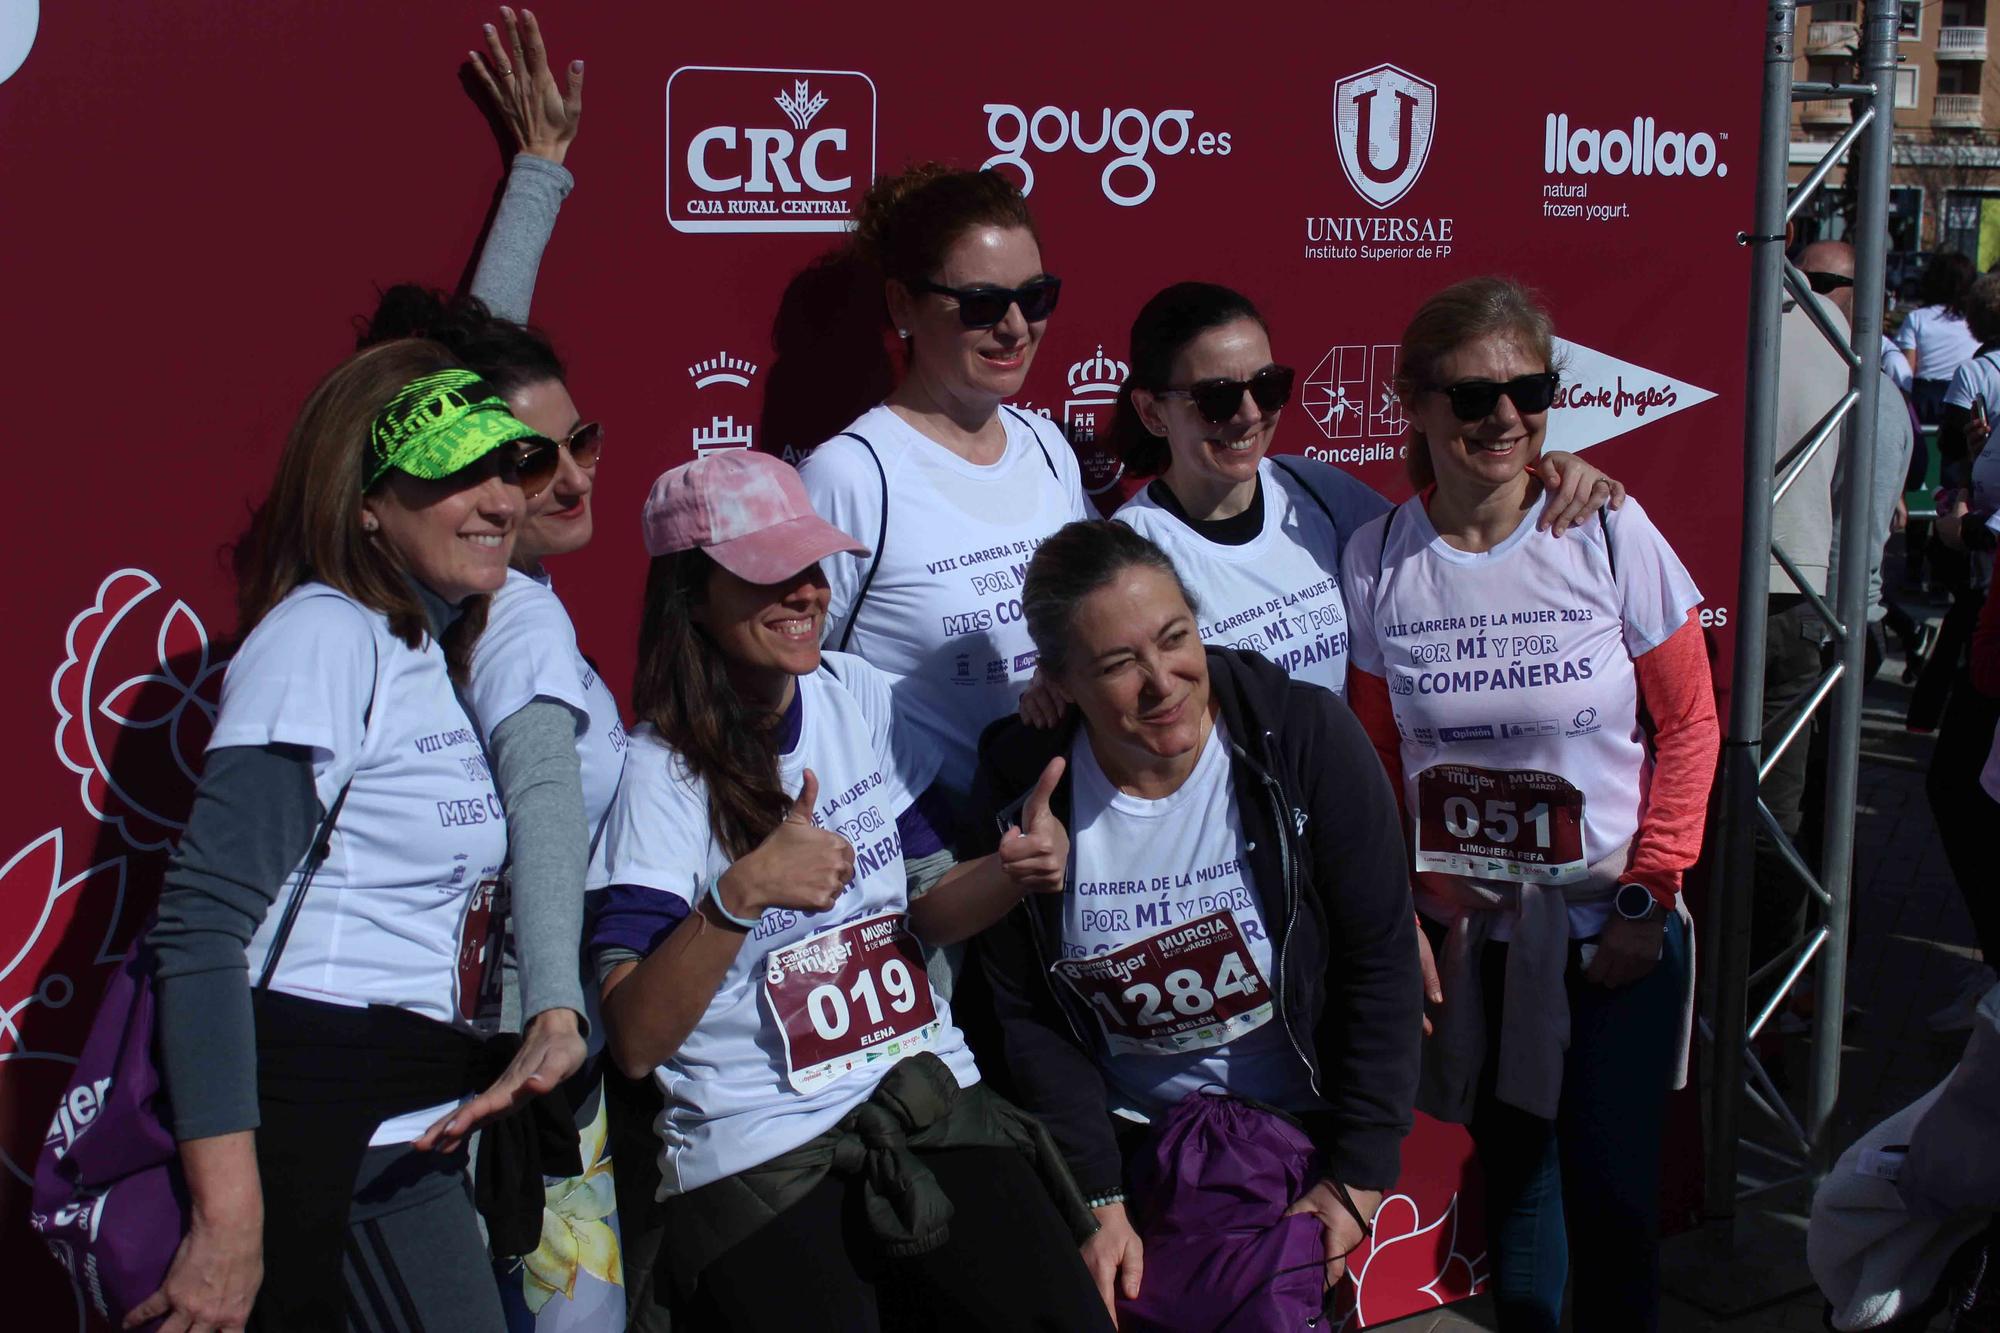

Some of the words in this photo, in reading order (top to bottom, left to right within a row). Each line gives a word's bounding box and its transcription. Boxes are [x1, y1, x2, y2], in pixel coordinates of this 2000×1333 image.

[687, 126, 851, 192] CRC
[979, 103, 1231, 206] gougo.es
[1544, 183, 1587, 197] natural
[687, 200, 724, 214] CAJA
[728, 200, 778, 213] RURAL
[781, 200, 850, 214] CENTRAL
[1543, 201, 1583, 217] frozen
[1586, 202, 1630, 221] yogurt.
[1307, 217, 1453, 242] UNIVERSAE
[1305, 245, 1357, 259] Instituto
[1360, 245, 1414, 261] Superior
[1416, 246, 1432, 259] de
[1436, 245, 1452, 258] FP
[1569, 383, 1612, 409] Corte
[1305, 443, 1394, 466] Concejalía
[926, 558, 957, 575] VIII
[959, 544, 1012, 566] CARRERA
[1012, 541, 1028, 554] DE
[971, 570, 1014, 596] POR
[1214, 606, 1265, 635] CARRERA
[1265, 598, 1282, 613] DE
[1282, 592, 1299, 607] LA
[1299, 580, 1330, 601] MUJER
[943, 610, 993, 637] MIS
[1263, 611, 1294, 645] MÍ
[1292, 614, 1311, 635] Y
[1308, 603, 1343, 631] POR
[1384, 624, 1408, 637] VIII
[1410, 617, 1466, 635] CARRERA
[1470, 615, 1487, 628] DE
[1491, 613, 1508, 626] LA
[1511, 610, 1556, 625] MUJER
[1560, 609, 1593, 622] 2023
[1410, 643, 1451, 664] POR
[1456, 629, 1487, 660] MÍ
[1491, 638, 1508, 658] Y
[1512, 635, 1558, 657] POR
[1418, 657, 1593, 695] COMPAÑERAS
[415, 734, 442, 754] VIII
[1449, 770, 1495, 793] mujer
[437, 798, 487, 827] MIS
[822, 799, 841, 817] LA
[1443, 796, 1550, 848] 051
[843, 806, 885, 842] POR
[1460, 843, 1515, 858] LIMONERA
[1079, 881, 1146, 896] CARRERA
[1151, 877, 1170, 891] DE
[1174, 873, 1192, 888] LA
[1196, 859, 1244, 881] MUJER
[1082, 908, 1130, 932] POR
[1135, 893, 1172, 928] MÍ
[1176, 900, 1194, 921] Y
[1199, 887, 1253, 914] POR
[753, 908, 798, 941] MIS
[1157, 918, 1229, 952] MURCIA
[782, 945, 820, 964] carrera
[807, 959, 916, 1041] 019
[1090, 952, 1259, 1027] 1284
[861, 1026, 896, 1046] ELENA
